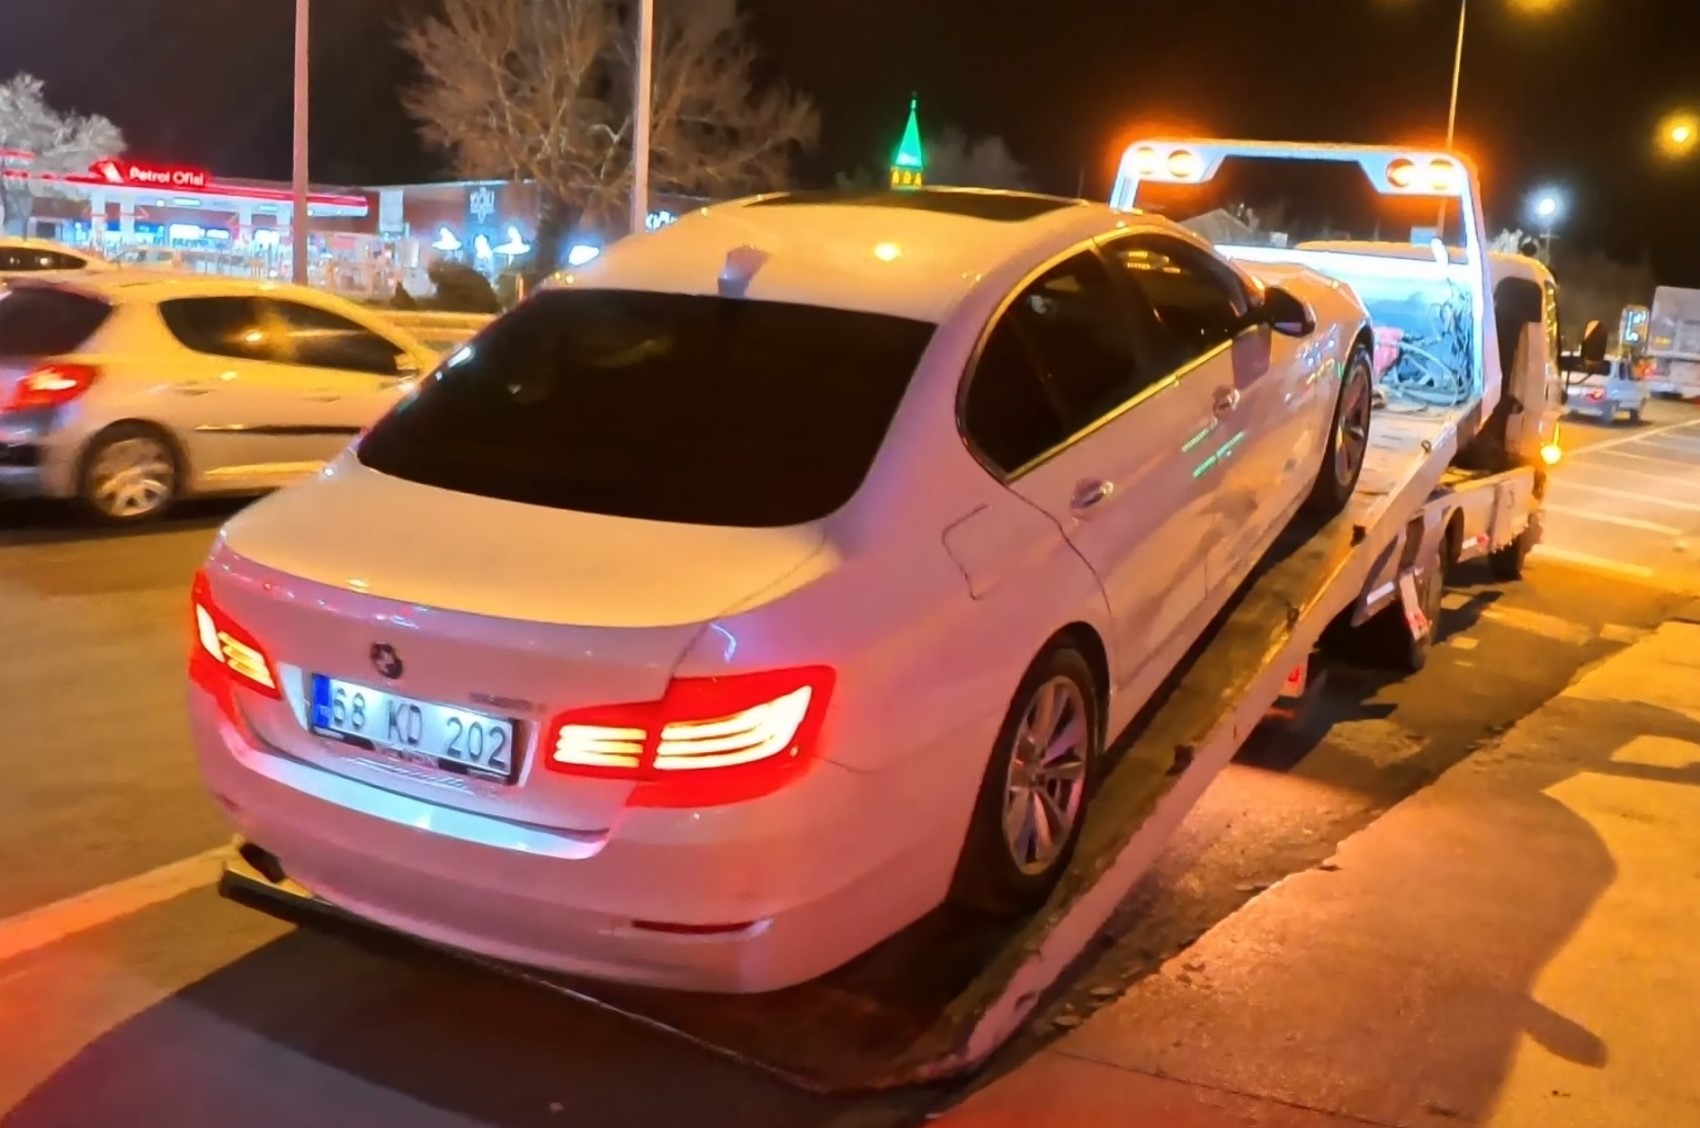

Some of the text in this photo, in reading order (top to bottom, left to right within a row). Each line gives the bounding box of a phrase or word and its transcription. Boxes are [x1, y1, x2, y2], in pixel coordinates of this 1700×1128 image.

[129, 165, 171, 183] Petrol
[333, 687, 366, 731] 68
[388, 699, 423, 744] KD
[447, 716, 507, 768] 202
